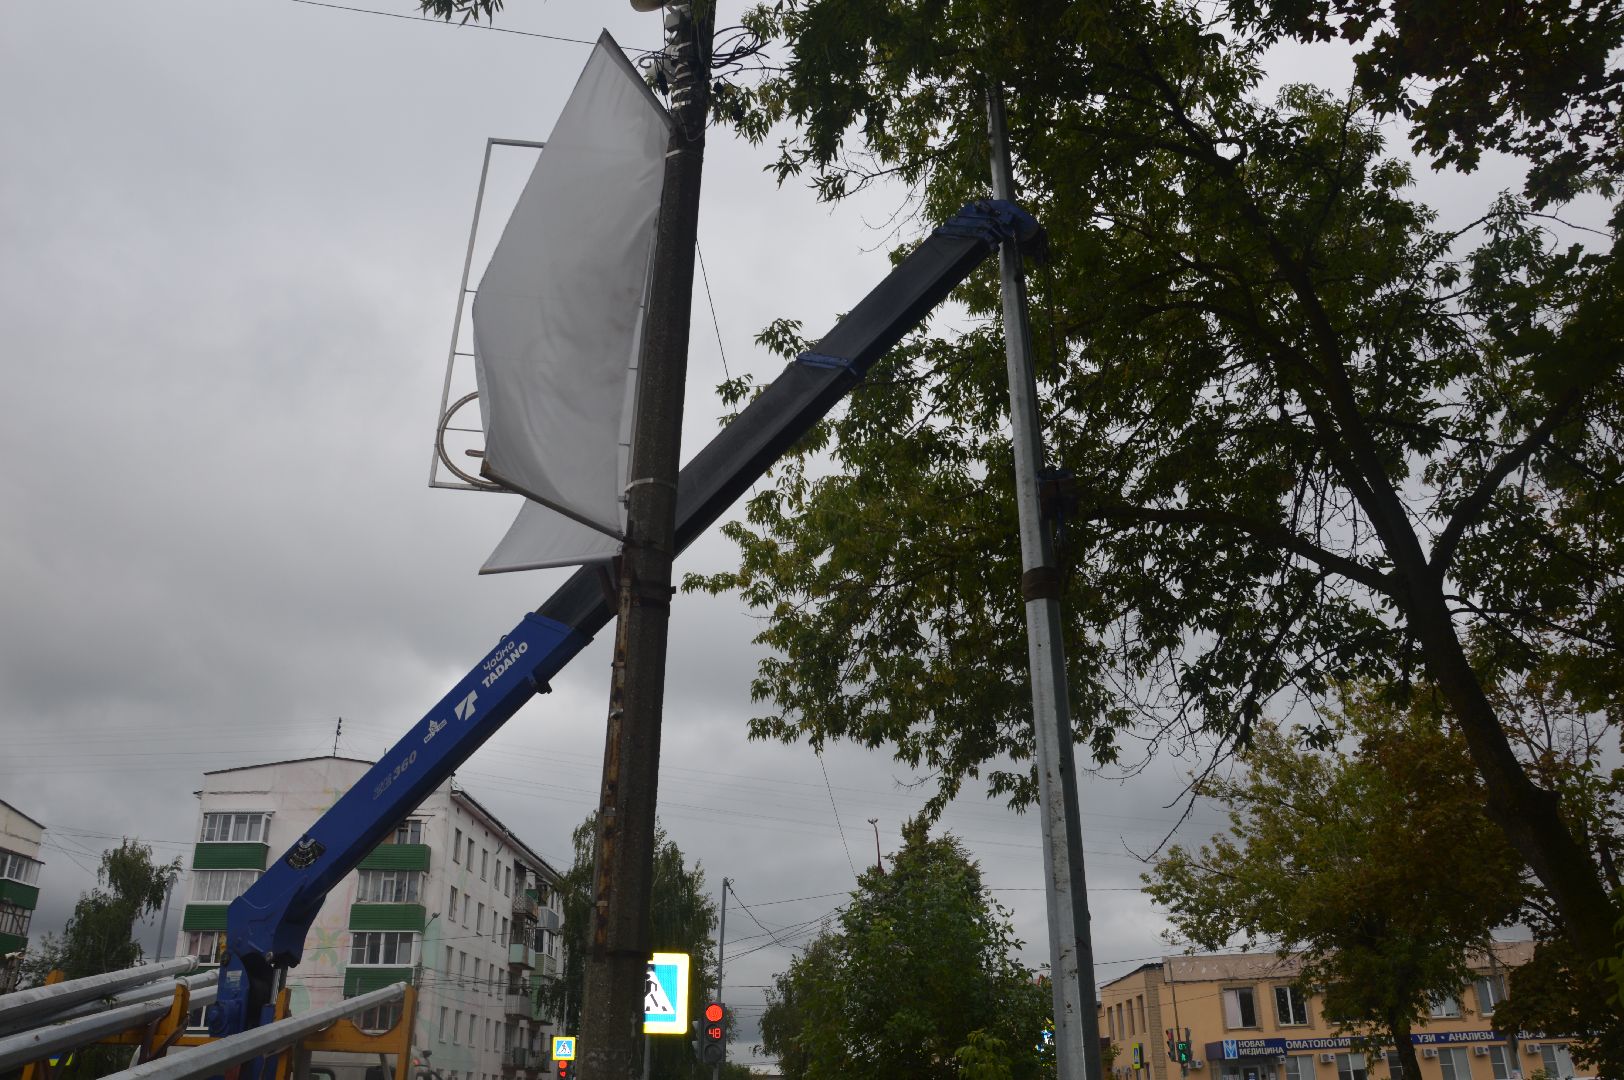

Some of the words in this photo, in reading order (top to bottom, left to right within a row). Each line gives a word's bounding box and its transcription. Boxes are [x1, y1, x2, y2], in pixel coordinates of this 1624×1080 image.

[481, 641, 528, 688] TADANO
[708, 1028, 721, 1039] 48
[1238, 1039, 1265, 1048] НОВАЯ
[1285, 1038, 1351, 1049] ОМАТОЛОГИЯ
[1417, 1034, 1436, 1043] УЗИ
[1448, 1031, 1495, 1042] АНАЛИЗЫ
[1239, 1046, 1284, 1056] МЕДИЦИНА
